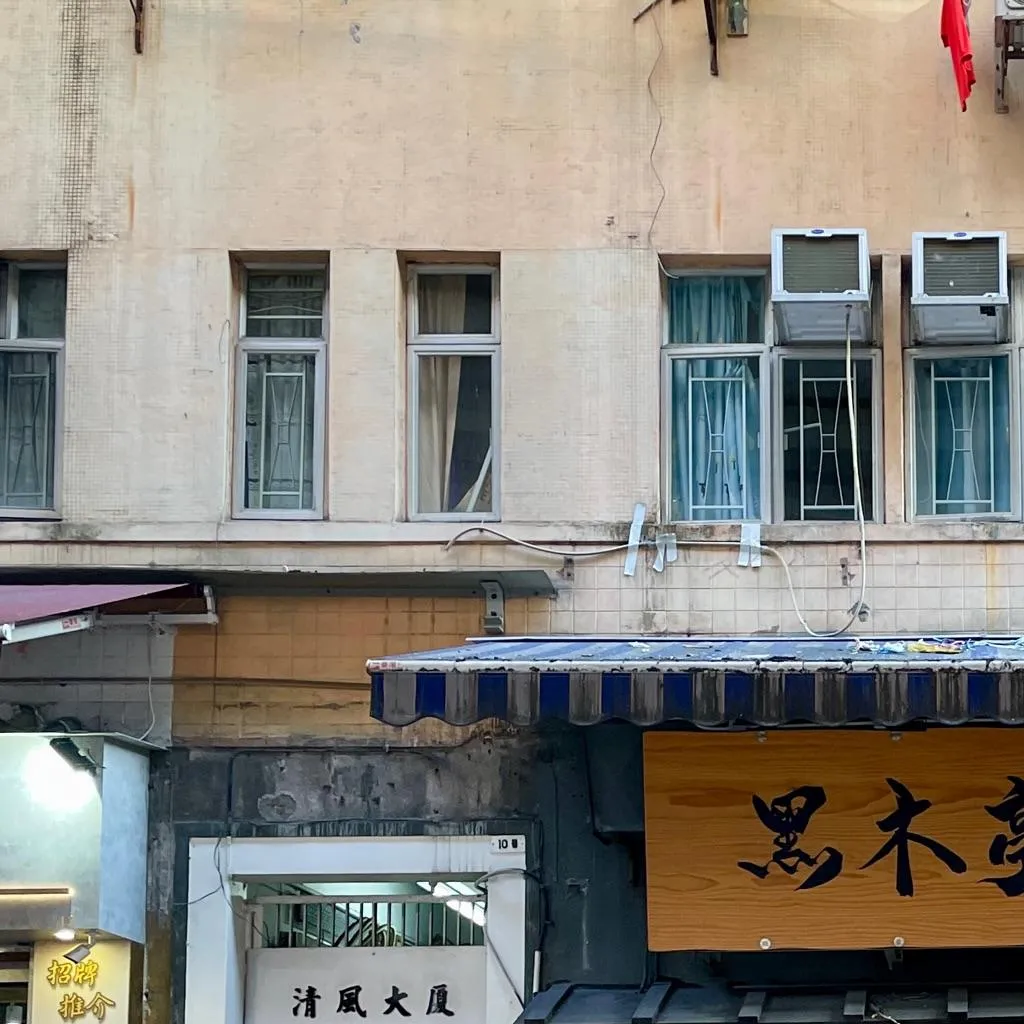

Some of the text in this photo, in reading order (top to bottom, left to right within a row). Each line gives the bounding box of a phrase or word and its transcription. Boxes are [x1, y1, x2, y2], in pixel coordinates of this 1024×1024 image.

[498, 839, 508, 849] 10
[46, 960, 98, 987] 招牌
[58, 992, 117, 1022] 推介
